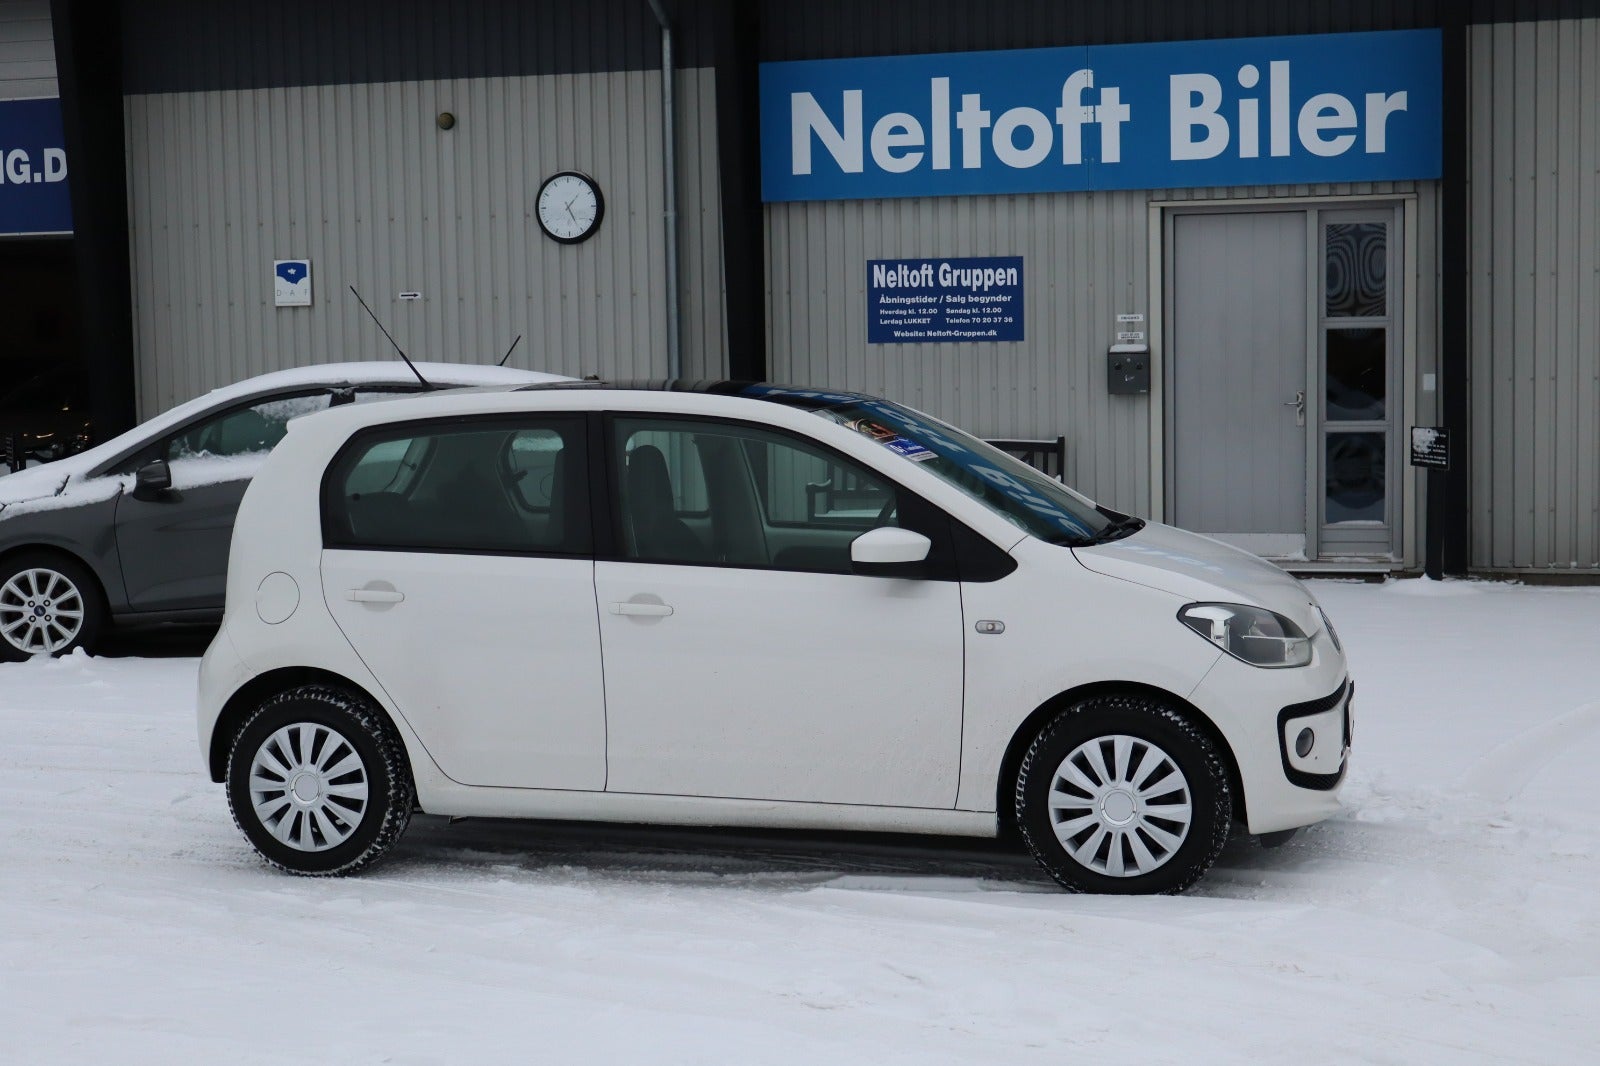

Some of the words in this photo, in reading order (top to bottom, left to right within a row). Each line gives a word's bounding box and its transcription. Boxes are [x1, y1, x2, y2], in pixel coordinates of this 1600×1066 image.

[790, 69, 1131, 176] Neltoft
[1169, 60, 1408, 162] Biler
[0, 147, 68, 184] G.D
[873, 263, 934, 288] Neltoft
[938, 262, 1018, 291] Gruppen
[879, 294, 938, 304] Åbningstider
[945, 294, 966, 304] Salg
[968, 294, 1012, 303] begynder
[893, 330, 926, 338] Website:
[926, 330, 998, 338] Neltoft-Gruppen.dk
